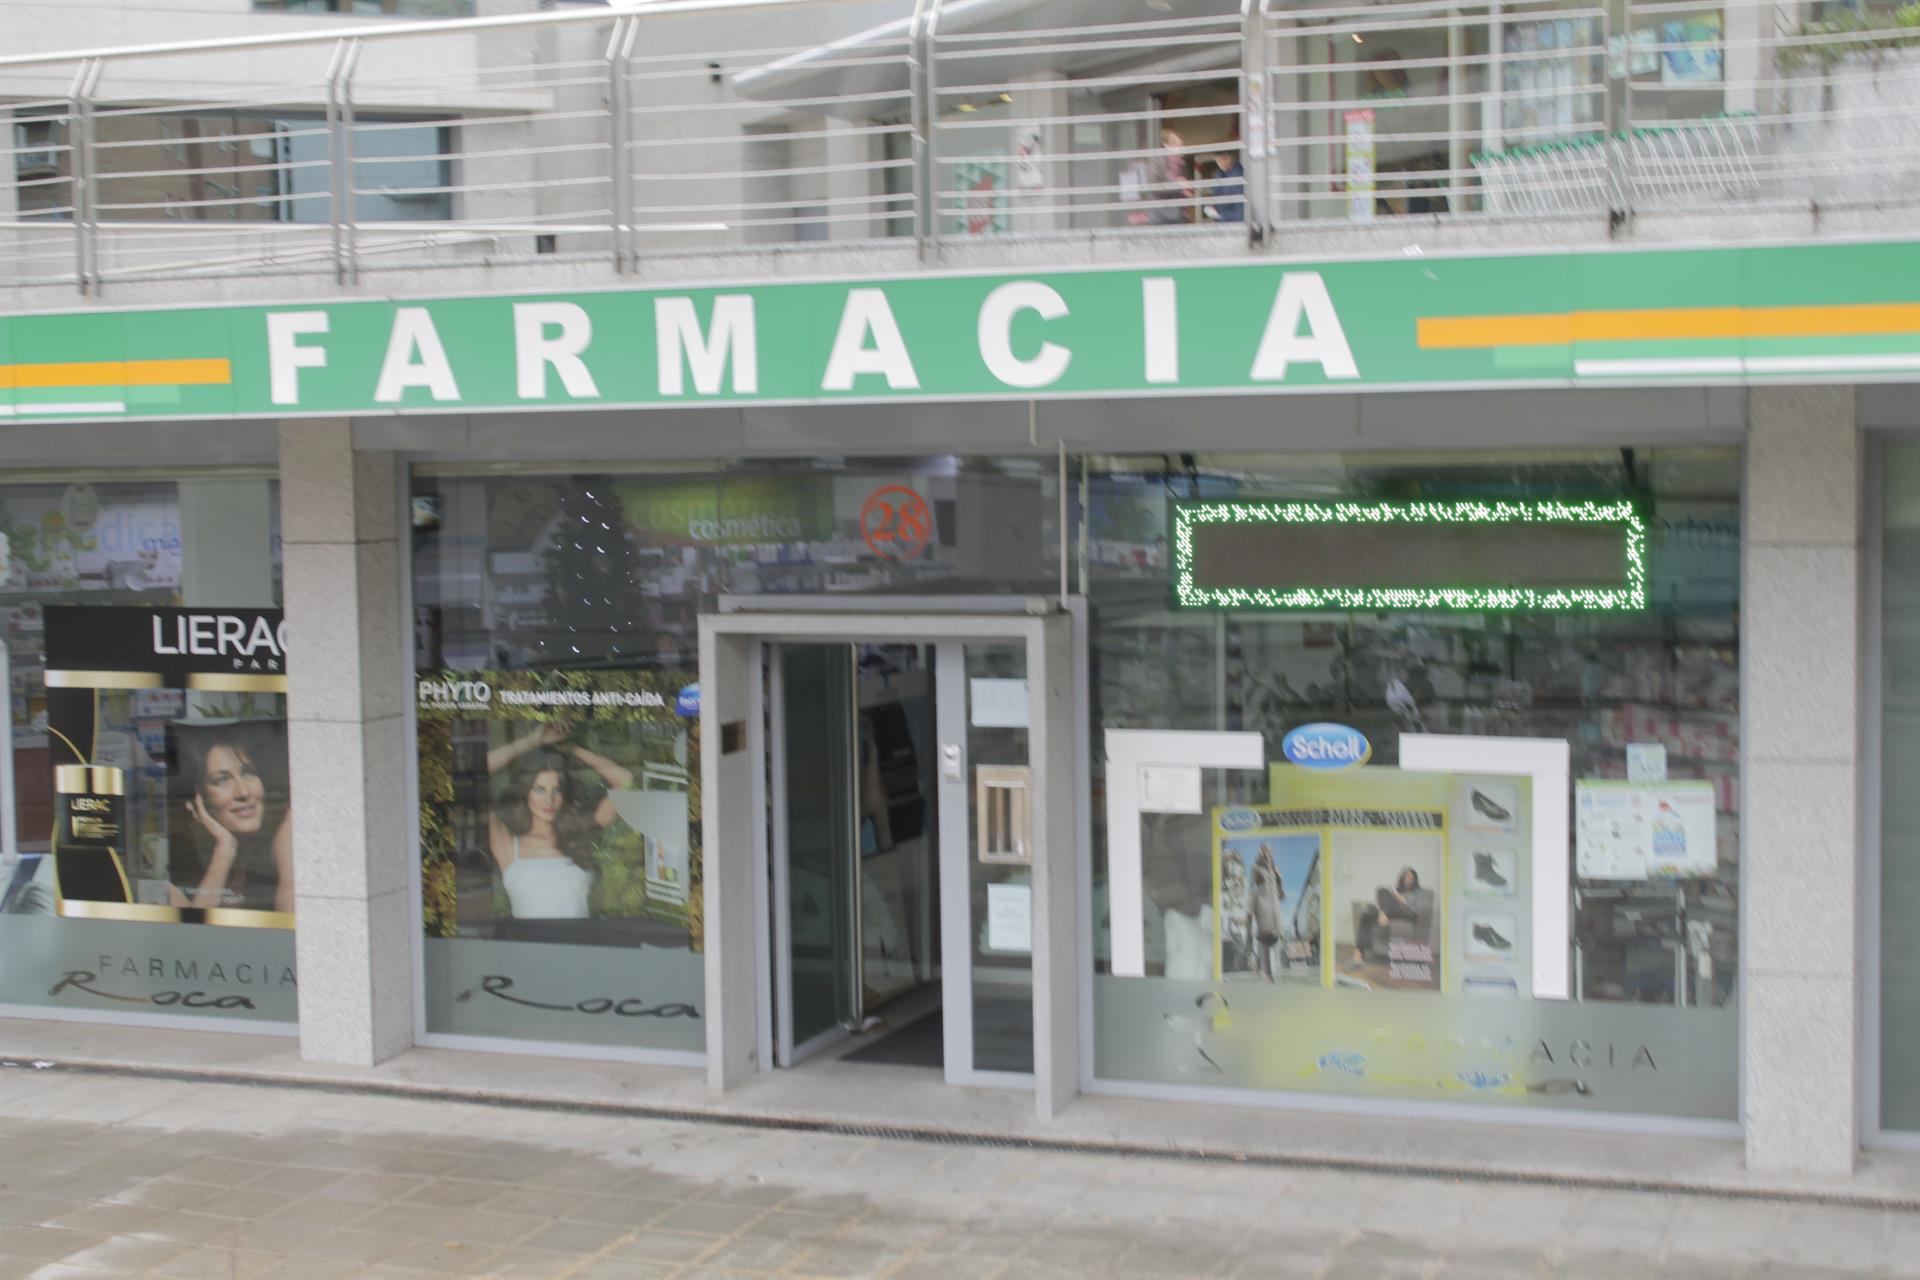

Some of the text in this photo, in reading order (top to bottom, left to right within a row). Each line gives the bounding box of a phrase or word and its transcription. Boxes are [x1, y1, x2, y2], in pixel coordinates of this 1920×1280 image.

[266, 271, 1361, 405] FARMACIA
[873, 500, 924, 542] 28
[419, 681, 492, 702] PHYTO
[1291, 735, 1362, 760] Scholl
[97, 955, 297, 986] FARMACIA
[48, 970, 256, 1010] Roca
